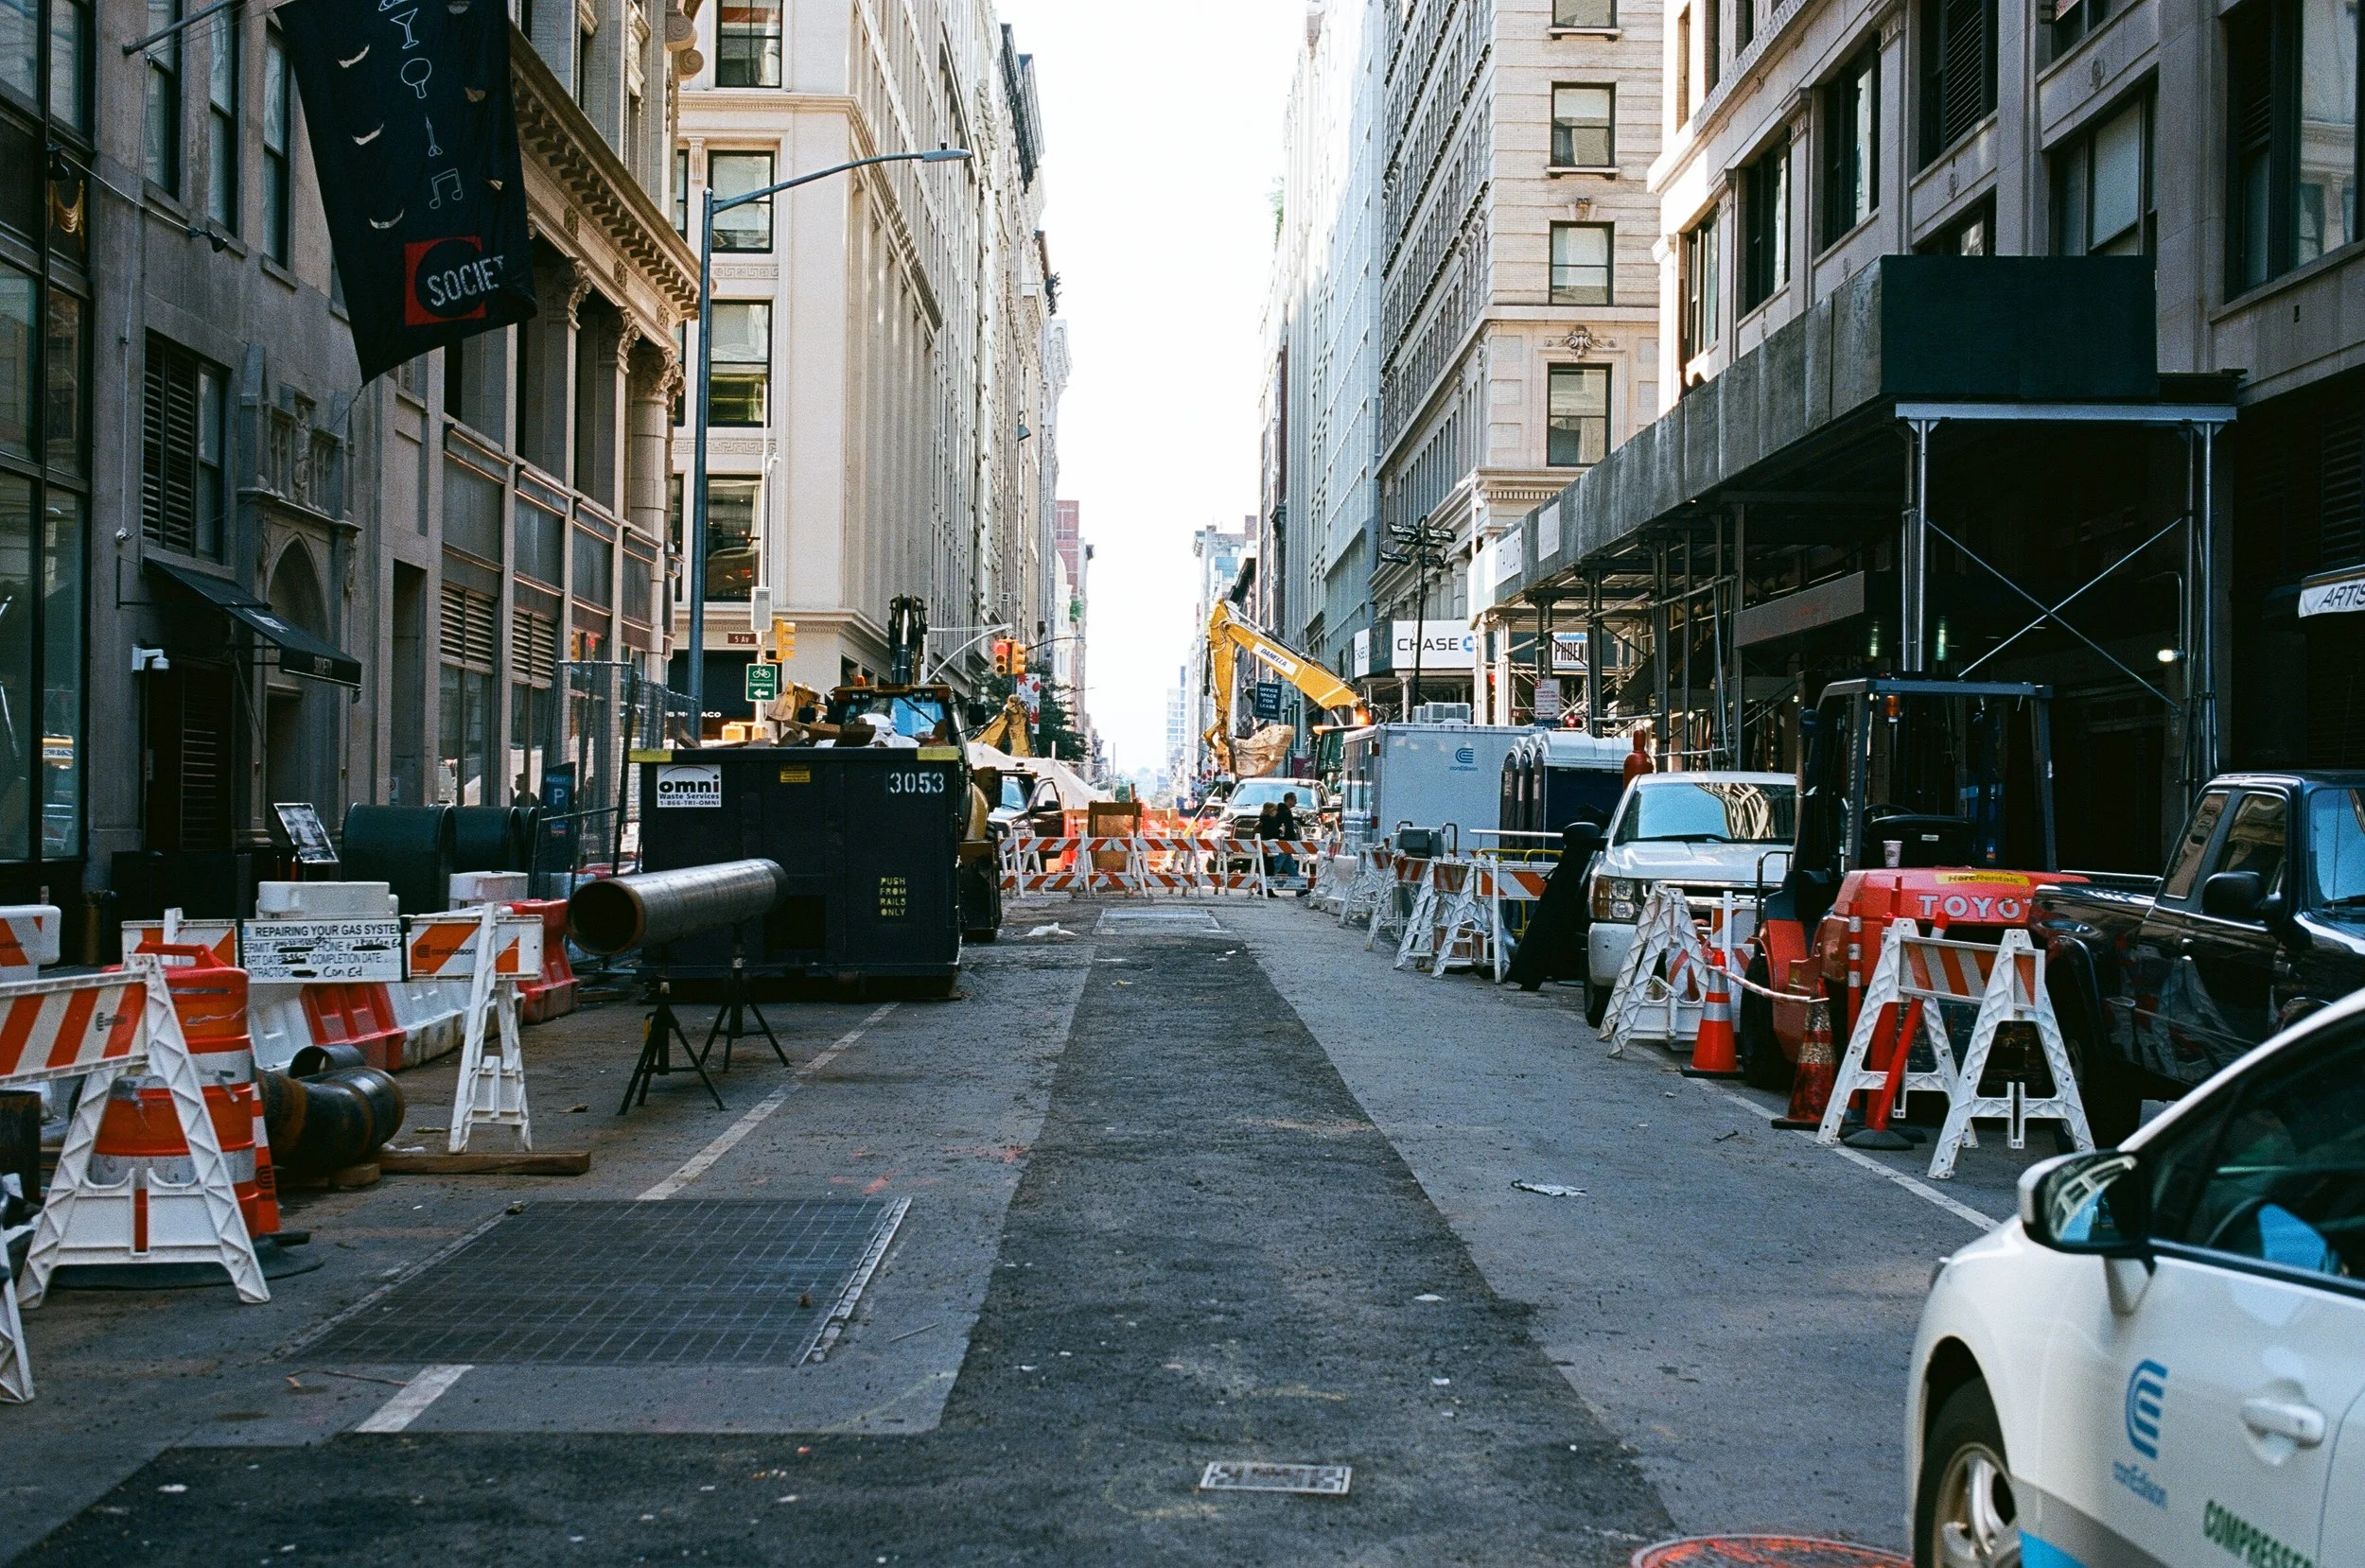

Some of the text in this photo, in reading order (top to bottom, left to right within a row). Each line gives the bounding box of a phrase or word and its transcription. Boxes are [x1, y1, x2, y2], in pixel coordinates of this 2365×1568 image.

[1396, 637, 1459, 652] CHASE
[1260, 648, 1288, 668] DANELLA
[658, 774, 720, 793] omni
[889, 772, 945, 794] 3053
[880, 877, 906, 885] PUSH
[880, 887, 907, 896] FROM
[880, 897, 907, 906] RAILS
[880, 908, 906, 916] ONLY
[254, 927, 308, 937] REPAIRING
[310, 926, 339, 936] YOUR
[341, 925, 362, 936] GAS
[311, 953, 360, 966] COMPLETION
[323, 966, 363, 978] Con Ed
[2203, 1498, 2314, 1568] COMPRESS
